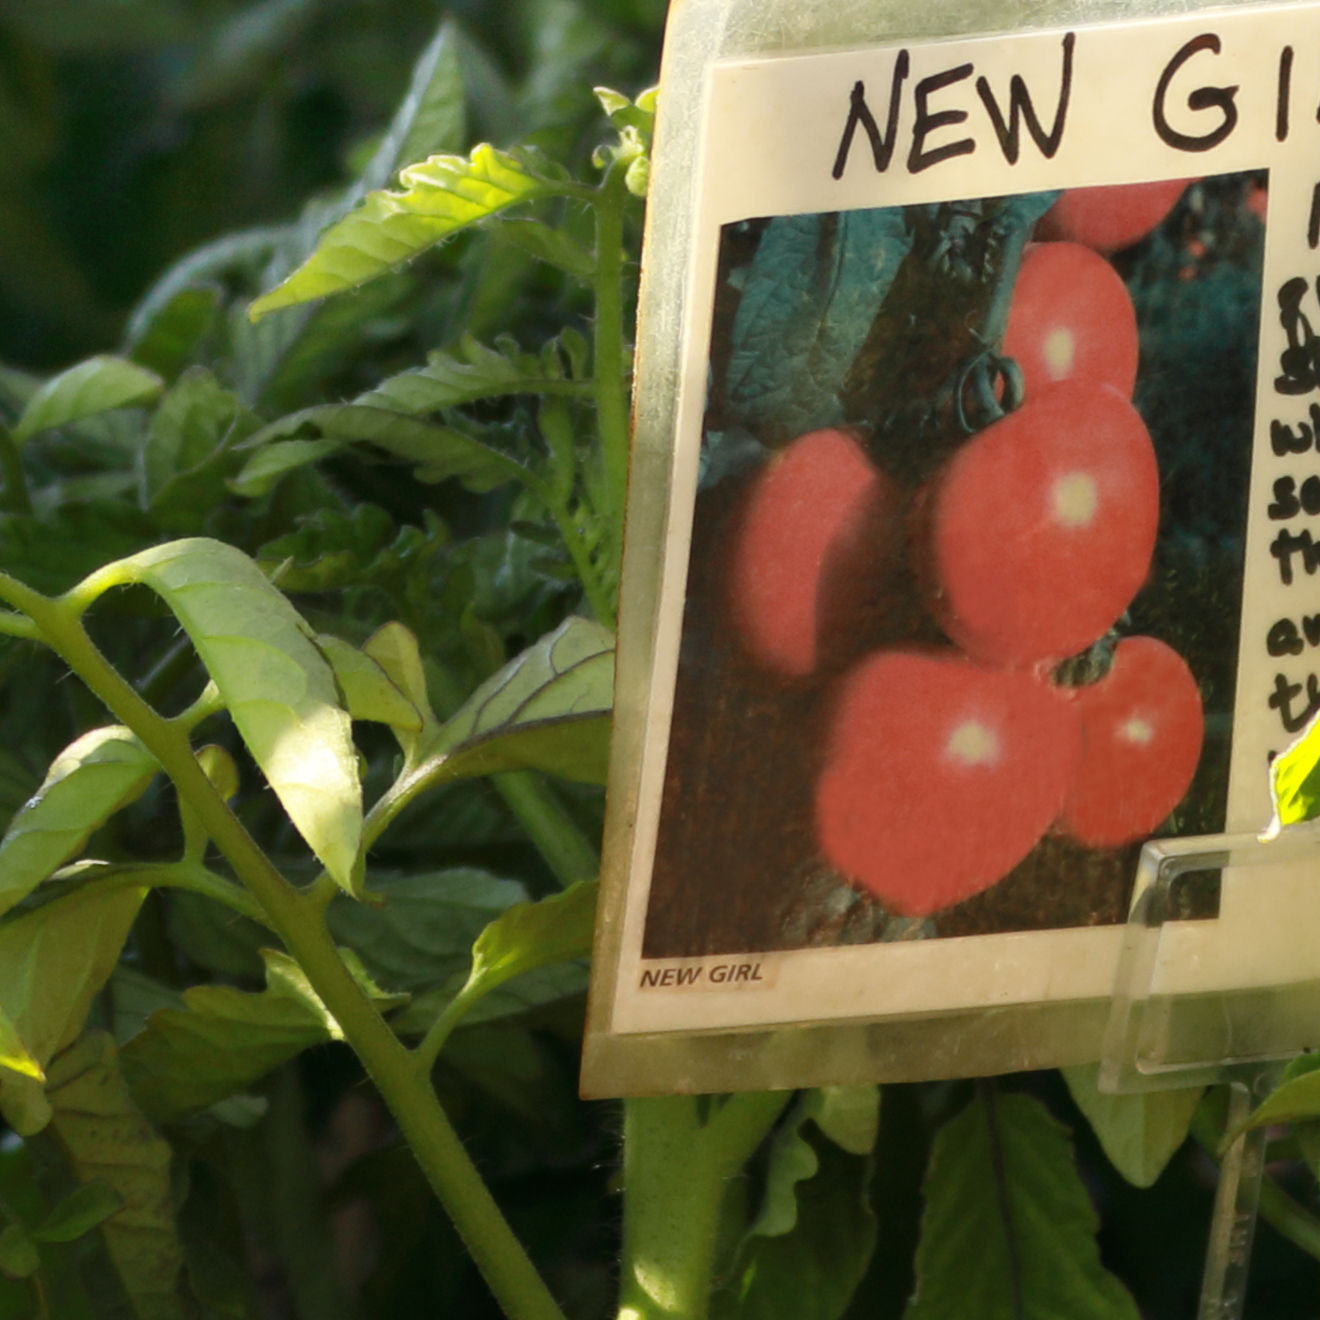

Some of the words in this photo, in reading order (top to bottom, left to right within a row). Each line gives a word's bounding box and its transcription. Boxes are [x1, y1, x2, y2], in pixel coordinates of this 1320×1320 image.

[832, 31, 1076, 180] NEW
[639, 966, 703, 989] NEW
[708, 962, 764, 984] GIRL
